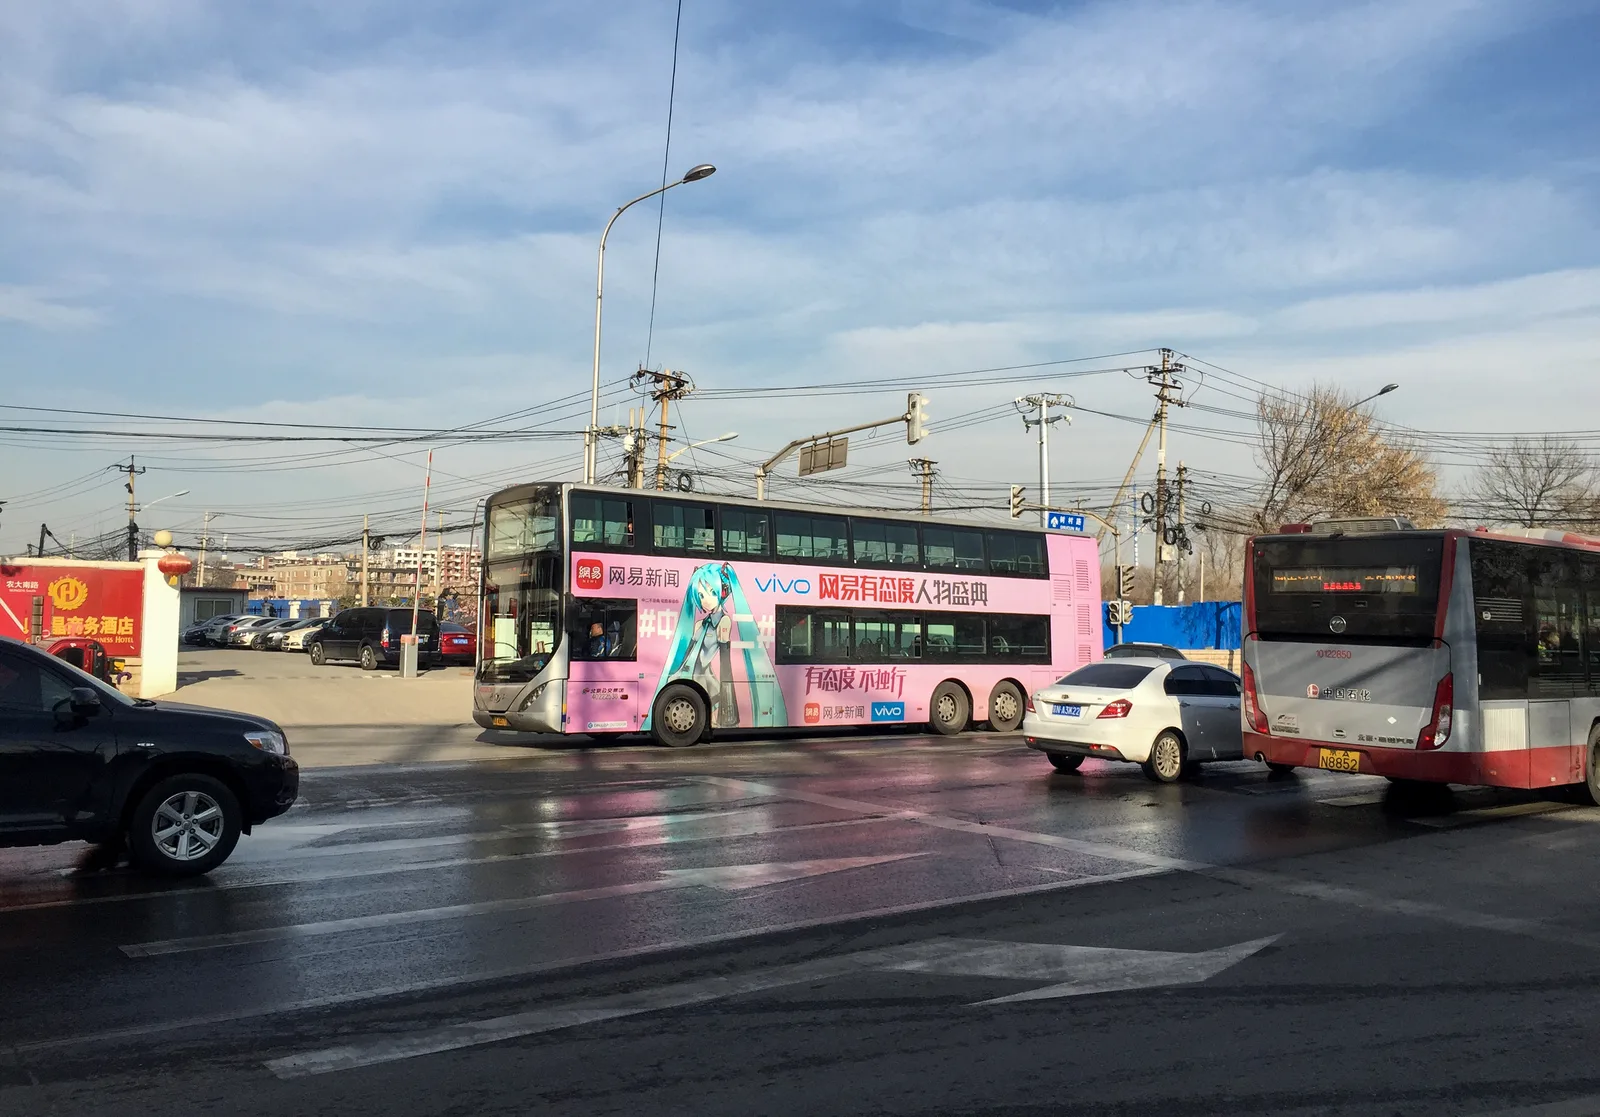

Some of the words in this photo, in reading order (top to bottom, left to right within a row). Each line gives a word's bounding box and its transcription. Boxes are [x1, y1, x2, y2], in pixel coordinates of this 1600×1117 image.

[578, 566, 601, 579] 網易
[609, 566, 679, 587] 网易新闻
[6, 580, 39, 589] 农大南路
[755, 573, 811, 594] vivo
[819, 573, 989, 606] 网易有态度人物盛典
[1316, 649, 1352, 659] 10122850
[805, 666, 856, 696] 有态度
[858, 666, 907, 699] 不独行
[1323, 686, 1371, 701] 中国石化
[823, 705, 865, 719] 网易新闻
[874, 705, 902, 716] vivo
[1321, 756, 1358, 771] N8852
